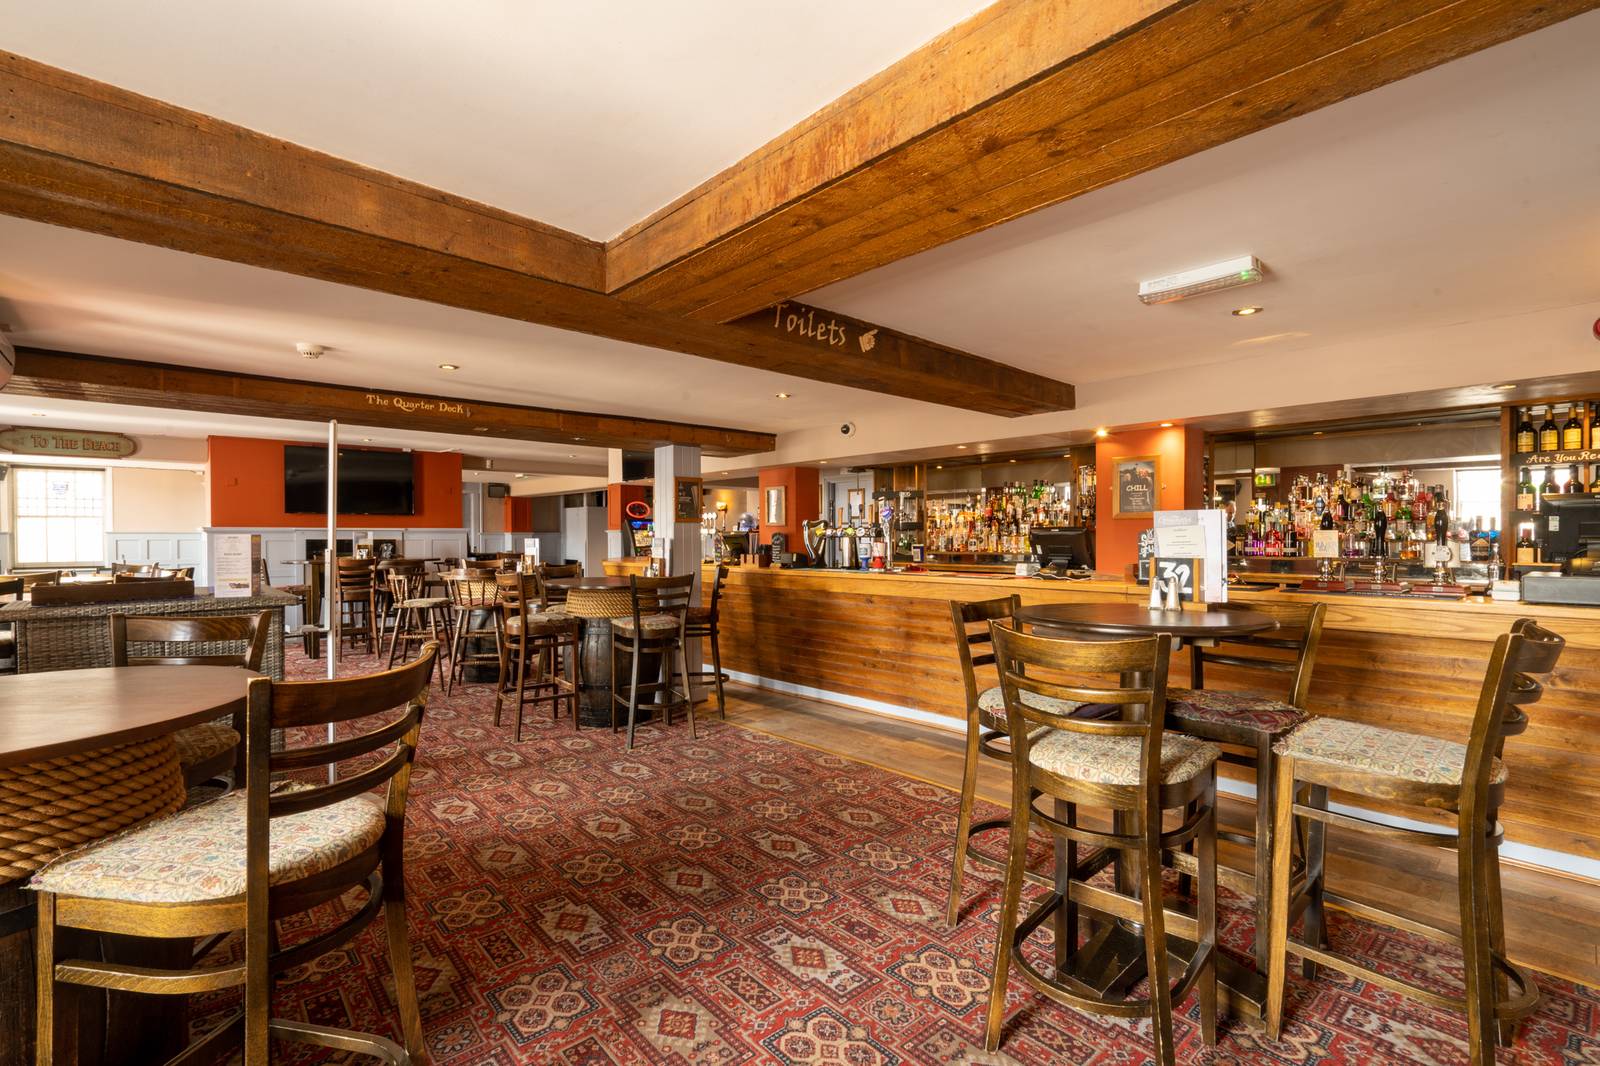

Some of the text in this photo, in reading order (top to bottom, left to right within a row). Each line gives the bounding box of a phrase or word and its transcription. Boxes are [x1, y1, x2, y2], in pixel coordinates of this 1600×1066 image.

[772, 303, 846, 346] Toilets
[366, 394, 464, 414] The Quarter Deck
[82, 438, 121, 452] BEACH
[1526, 454, 1551, 464] Are
[1553, 453, 1577, 463] You
[1126, 484, 1149, 492] CHILL
